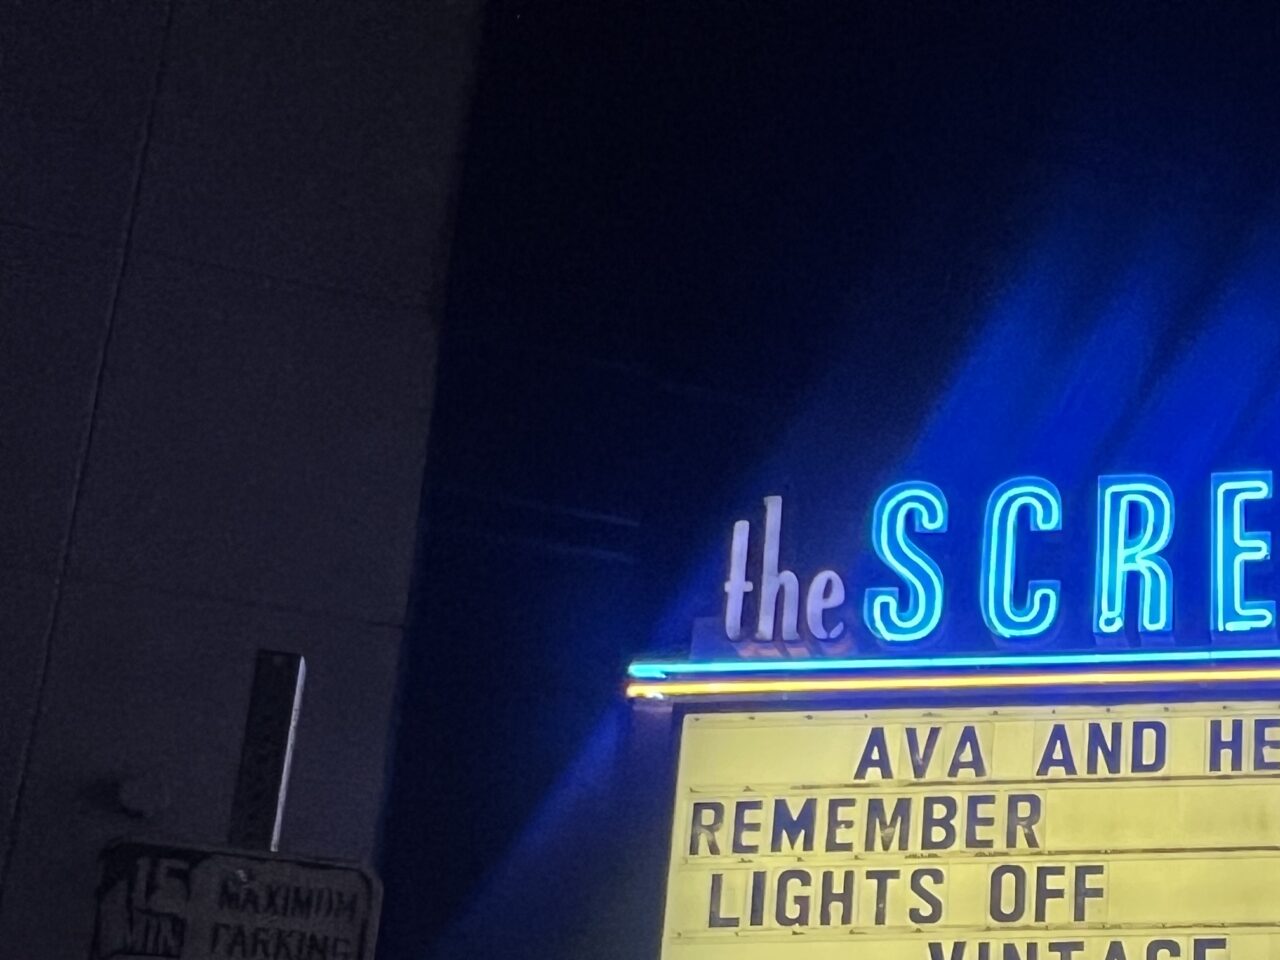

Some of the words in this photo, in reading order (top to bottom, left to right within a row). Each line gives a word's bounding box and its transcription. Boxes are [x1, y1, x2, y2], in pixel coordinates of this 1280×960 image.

[724, 496, 846, 642] the
[854, 724, 988, 781] AVA
[1036, 720, 1167, 776] AND
[688, 793, 1042, 856] REMEMBER
[708, 868, 945, 929] LIGHTS
[988, 864, 1105, 924] OFF
